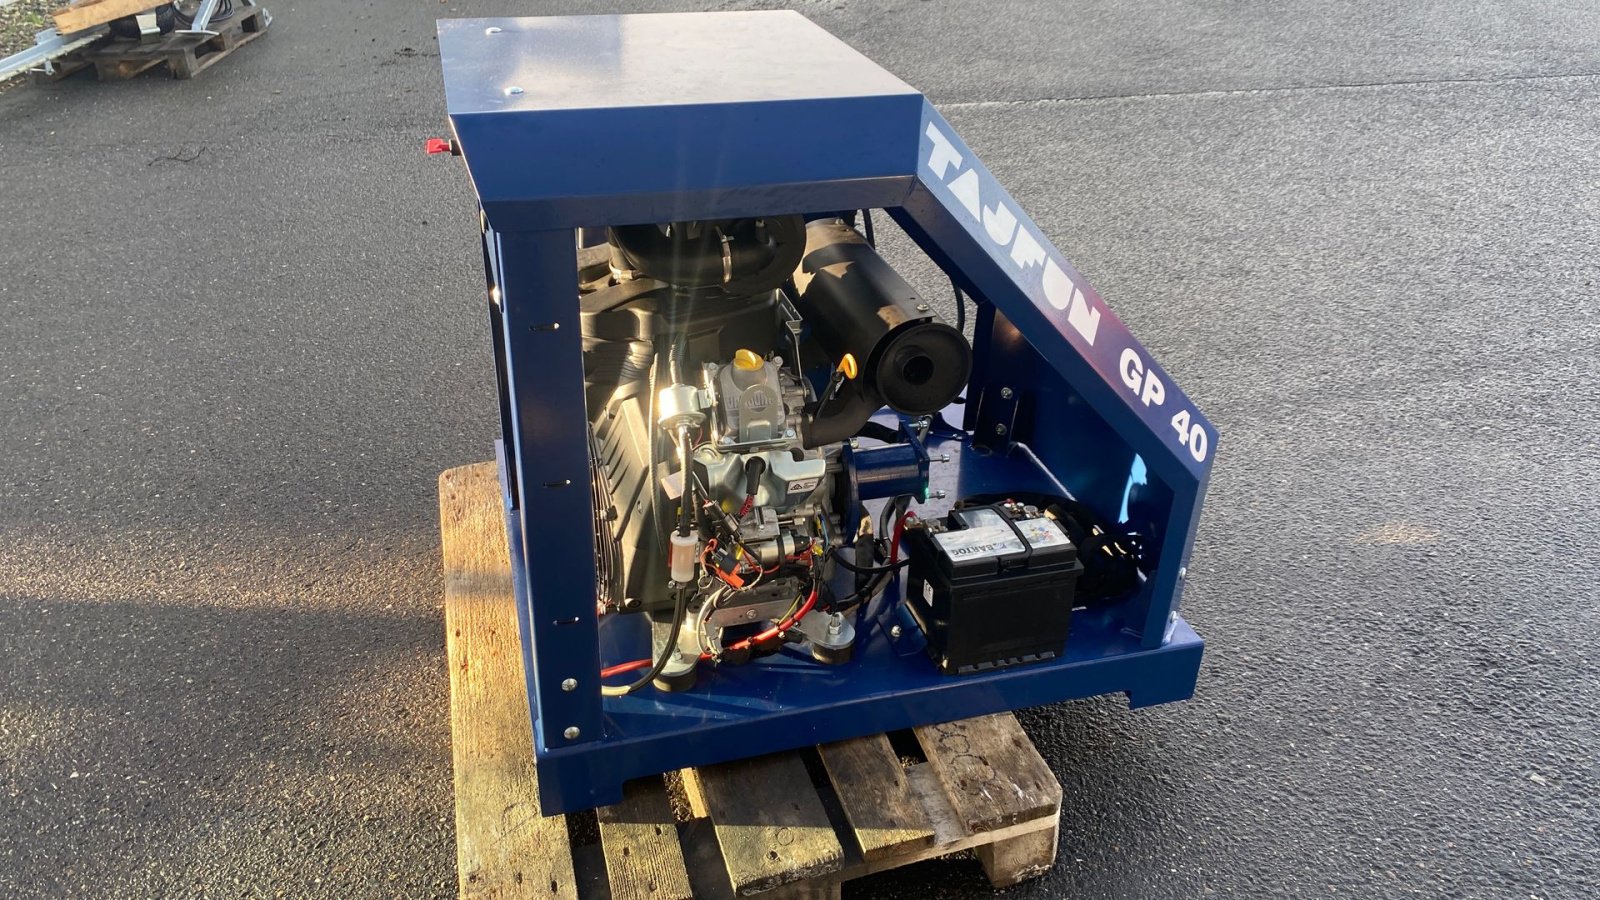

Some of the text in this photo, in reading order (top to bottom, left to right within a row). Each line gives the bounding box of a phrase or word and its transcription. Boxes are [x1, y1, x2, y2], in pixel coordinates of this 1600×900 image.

[926, 121, 1208, 462] TAJFUN GP 40
